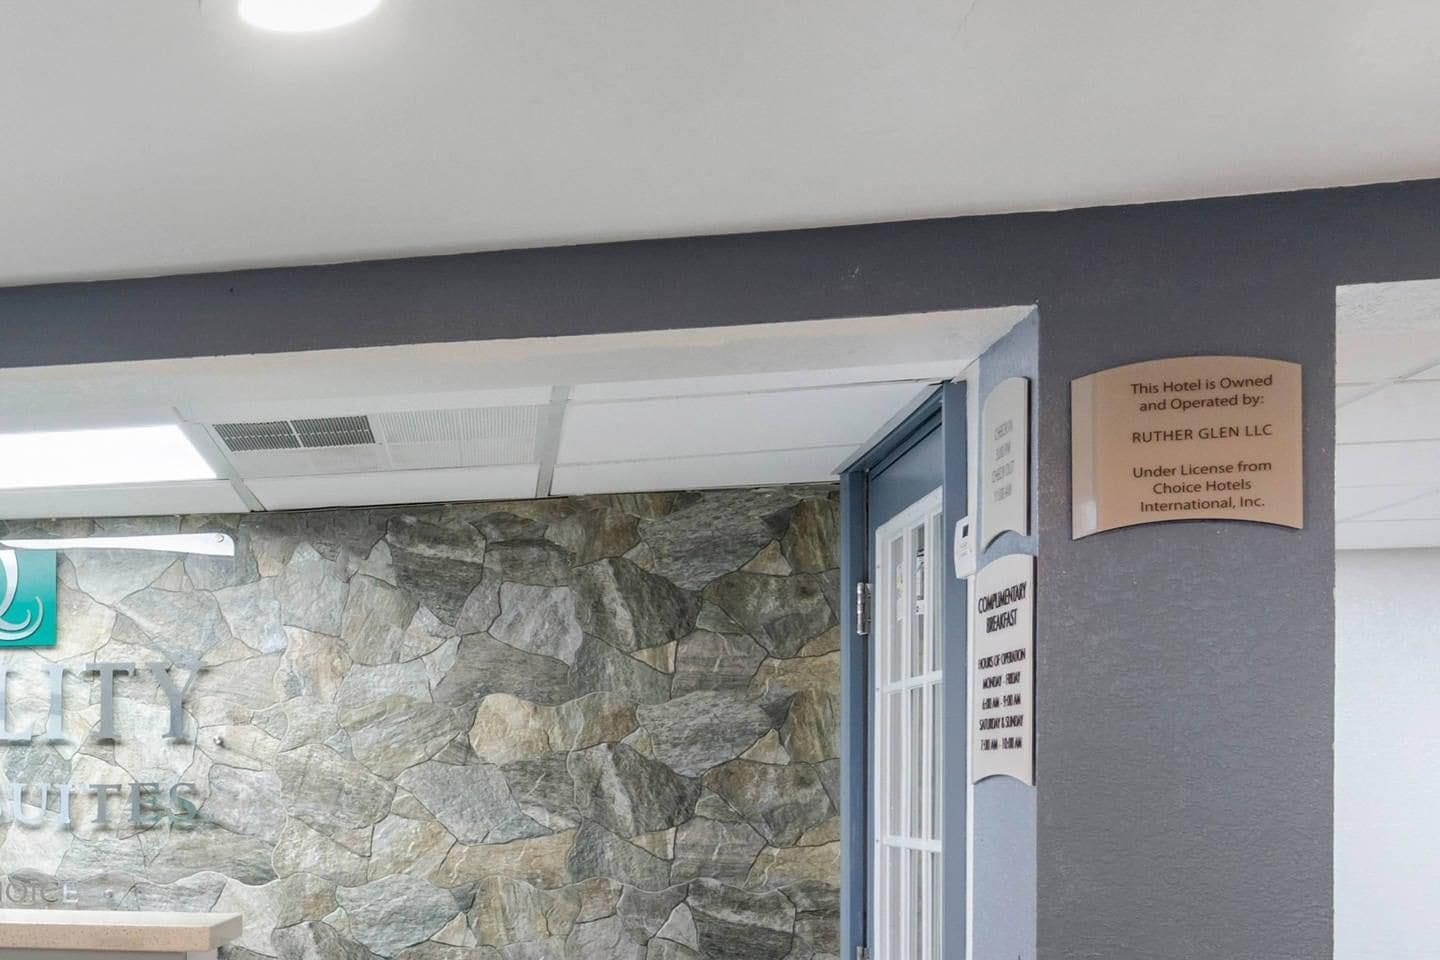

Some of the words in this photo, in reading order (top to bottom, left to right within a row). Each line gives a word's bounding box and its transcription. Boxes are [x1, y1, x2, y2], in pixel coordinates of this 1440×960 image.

[1131, 383, 1159, 394] This
[1163, 380, 1201, 392] Hotel
[1205, 379, 1216, 390] is
[1220, 374, 1273, 389] Owned
[1140, 399, 1166, 412] and
[1170, 394, 1238, 411] Operated
[1242, 393, 1264, 407] by:
[1132, 429, 1193, 443] RUTHER
[1198, 426, 1239, 439] GLEN
[1245, 424, 1272, 437] LLC
[1133, 465, 1176, 478] Under
[1181, 463, 1234, 476] License
[1237, 460, 1272, 472] from
[1153, 482, 1201, 494] Choice
[1206, 479, 1251, 491] Hotels
[1140, 496, 1236, 512] International,
[1240, 497, 1265, 508] Inc.
[977, 581, 1026, 614] COMPLIMENTARY
[986, 608, 1017, 633] BREAKFAST
[1001, 648, 1026, 665] OPERATION
